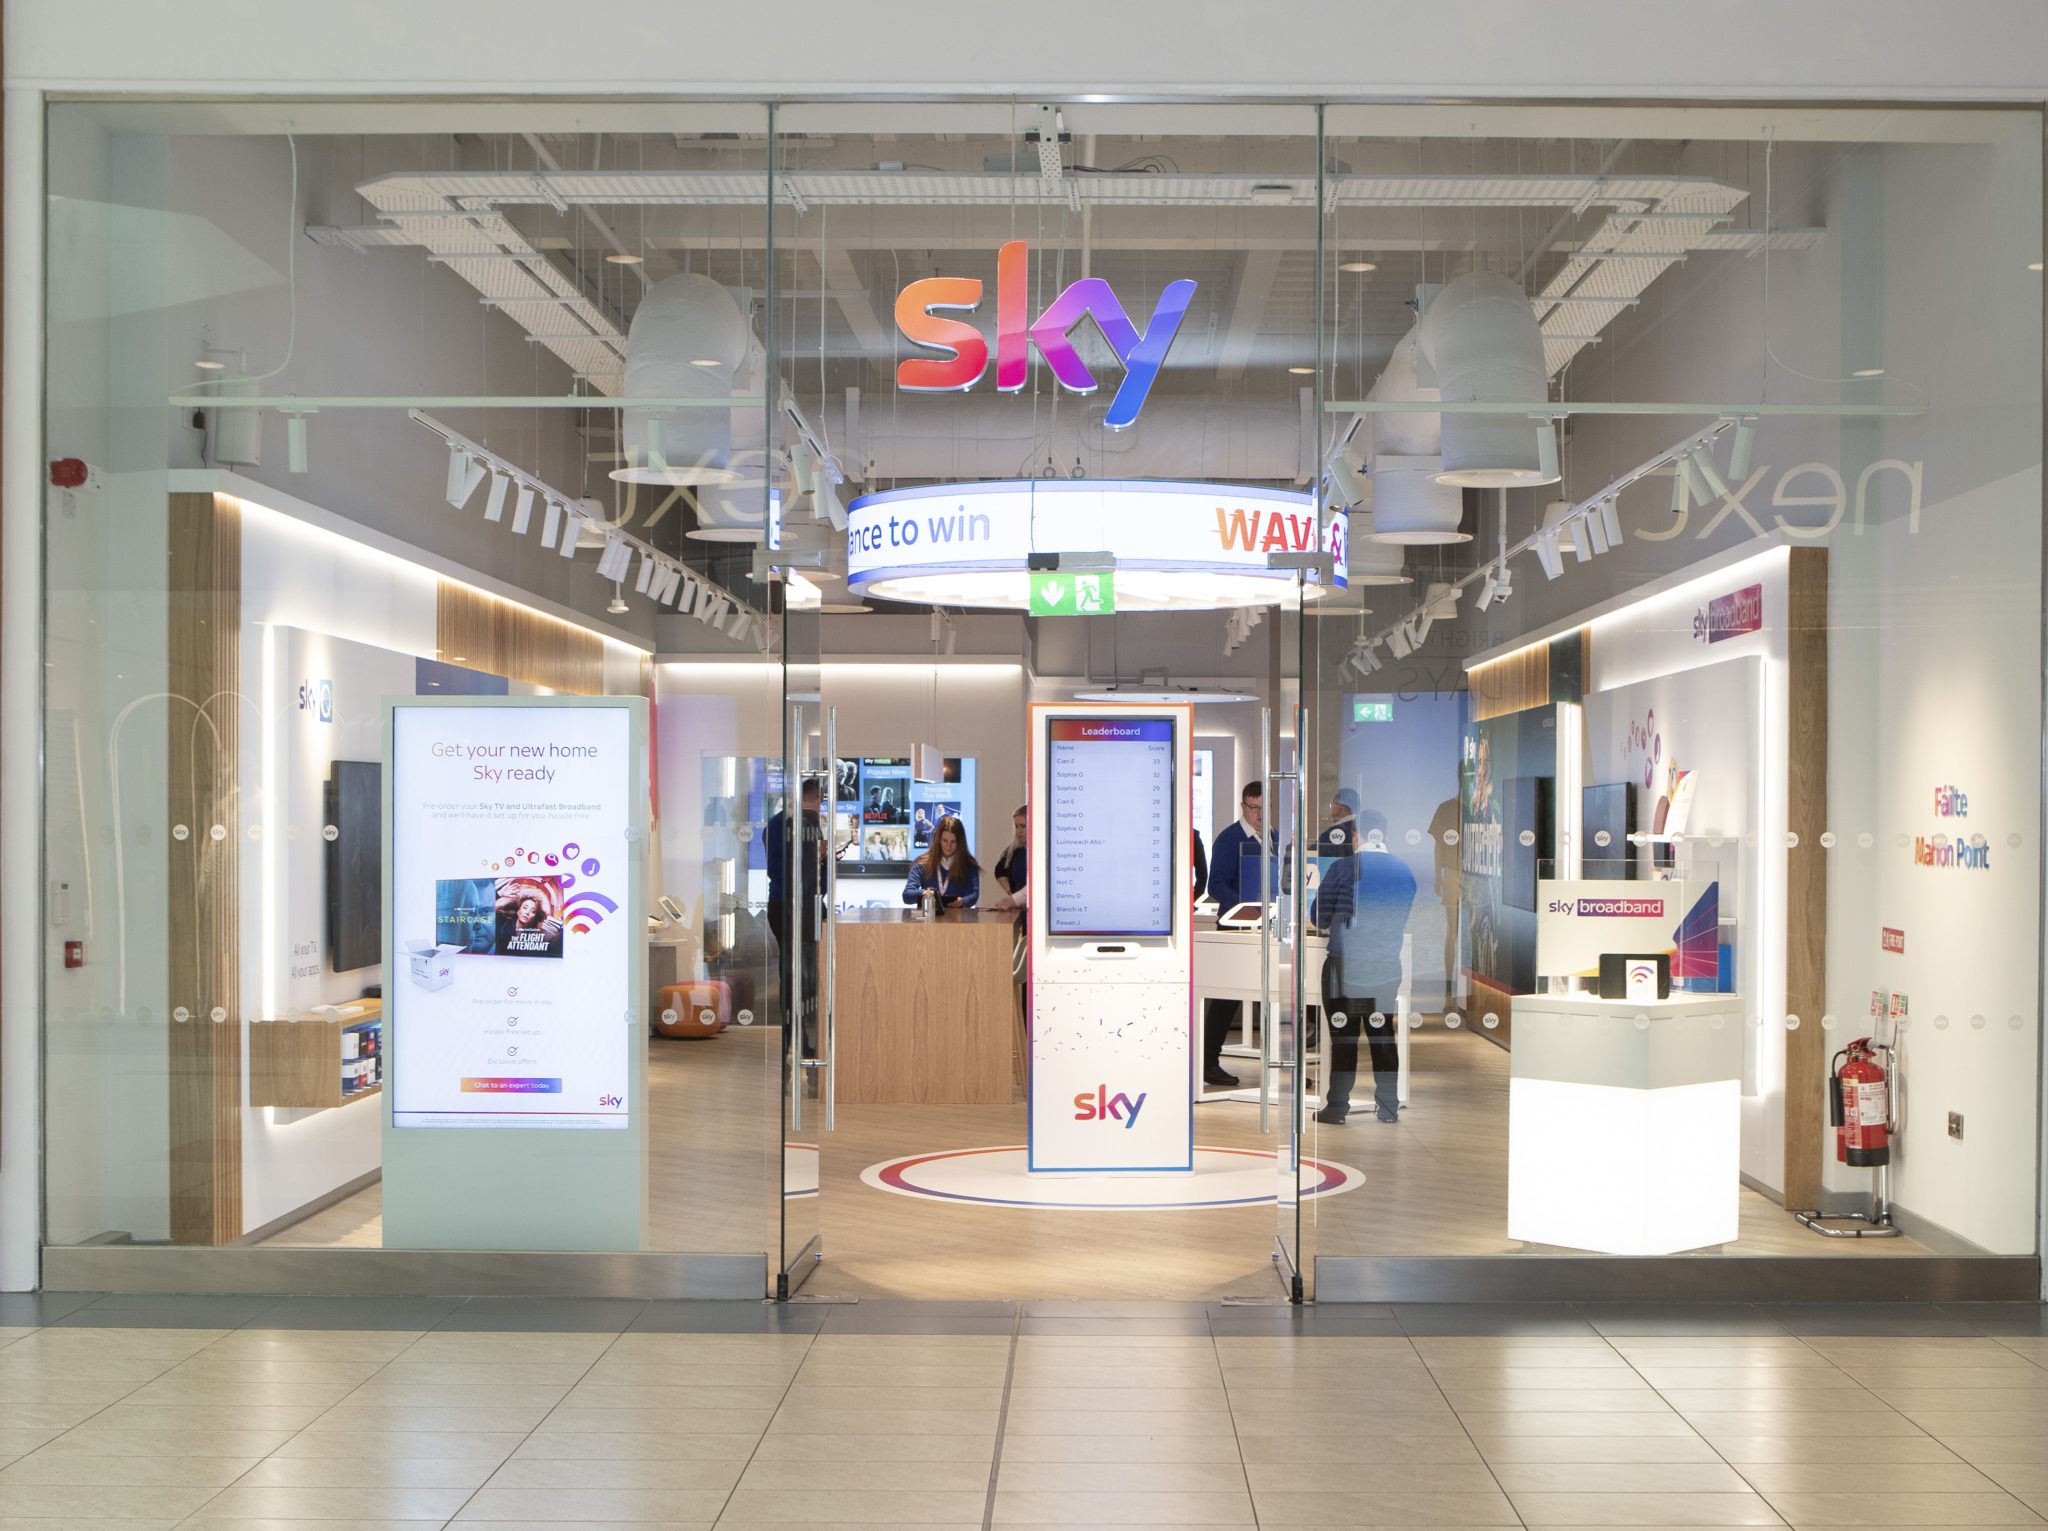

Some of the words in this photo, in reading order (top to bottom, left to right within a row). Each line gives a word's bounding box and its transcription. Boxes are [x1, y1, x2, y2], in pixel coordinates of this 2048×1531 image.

[894, 240, 1198, 428] sky
[889, 516, 919, 546] to
[928, 505, 989, 543] win
[1214, 508, 1317, 552] WAV
[1694, 607, 1708, 643] sky
[1711, 587, 1759, 632] broadband
[299, 679, 316, 718] sky
[1082, 727, 1140, 736] Leaderboard
[432, 742, 462, 757] Get
[467, 745, 505, 760] your
[510, 745, 545, 757] new
[550, 742, 598, 757] home
[473, 765, 502, 783] Sky
[507, 765, 555, 783] ready
[867, 768, 889, 776] Popular
[461, 804, 477, 812] your
[479, 803, 493, 812] Sky
[1935, 785, 1968, 817] Fáilte
[1915, 836, 1954, 867] Mahon
[1956, 837, 1990, 869] Point
[1549, 900, 1575, 916] sky
[1580, 900, 1661, 914] broadband
[438, 916, 494, 924] STAIRCASE
[507, 941, 550, 951] ATTENDANT
[520, 933, 545, 942] FLIGHT
[531, 1082, 550, 1090] today
[600, 1094, 623, 1108] sky
[1074, 1084, 1147, 1129] sky
